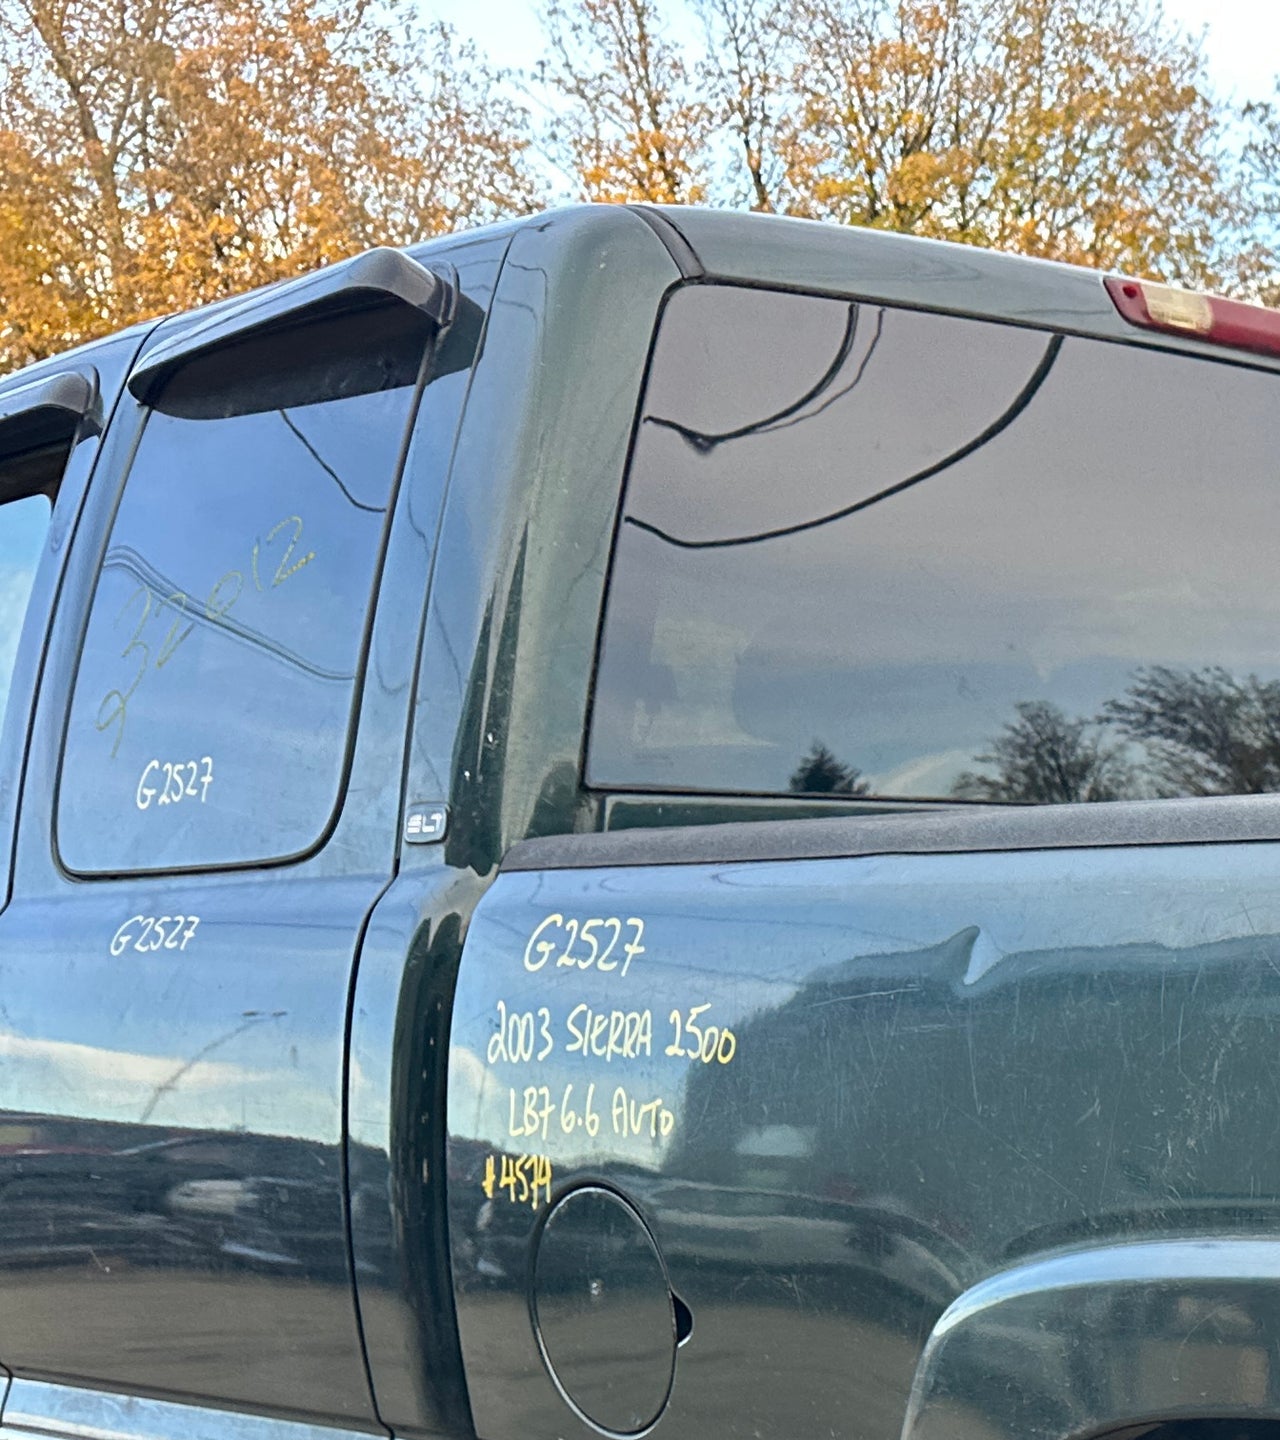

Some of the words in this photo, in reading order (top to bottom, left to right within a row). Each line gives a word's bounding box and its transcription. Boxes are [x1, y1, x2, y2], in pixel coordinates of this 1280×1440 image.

[136, 755, 213, 810] G2527
[406, 812, 443, 834] SLT
[110, 914, 201, 956] G2527
[523, 913, 646, 977] G2527
[487, 1000, 554, 1064] 2003
[566, 1003, 652, 1062] SIERRA
[665, 1002, 737, 1064] 2500
[509, 1086, 556, 1141] LB7
[560, 1083, 601, 1137] 6.6
